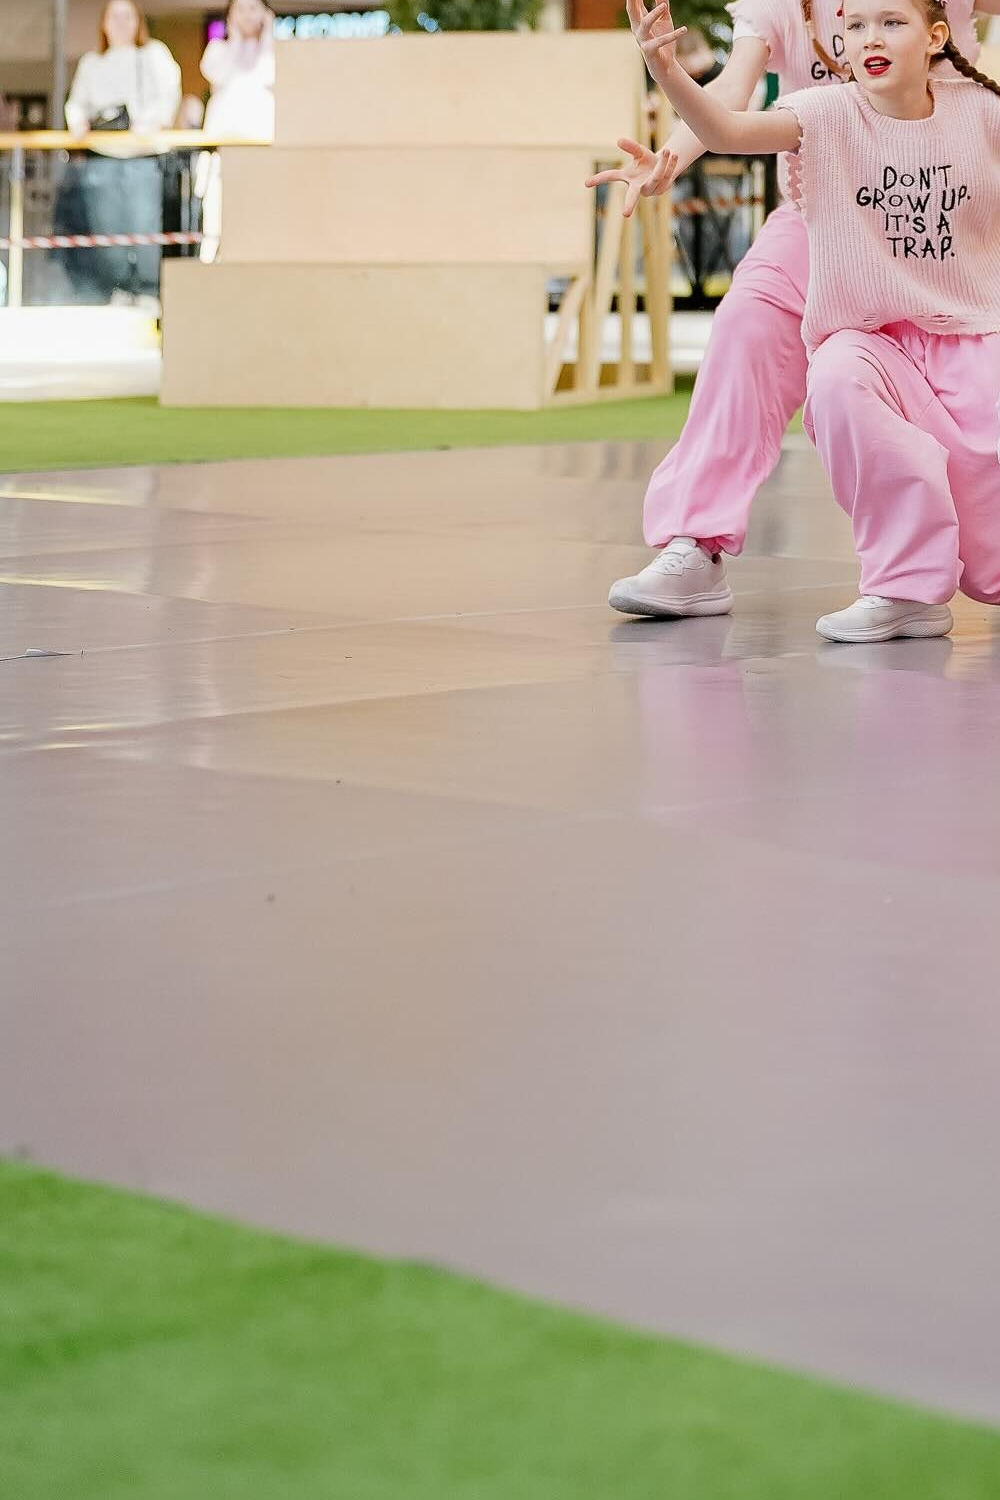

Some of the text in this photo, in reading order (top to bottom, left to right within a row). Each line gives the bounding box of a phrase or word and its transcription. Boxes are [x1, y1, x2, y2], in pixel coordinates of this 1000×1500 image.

[883, 165, 952, 191] DON'T
[856, 185, 971, 213] GROW UP.
[885, 211, 950, 235] IT'S A
[886, 236, 955, 261] TRAP.
